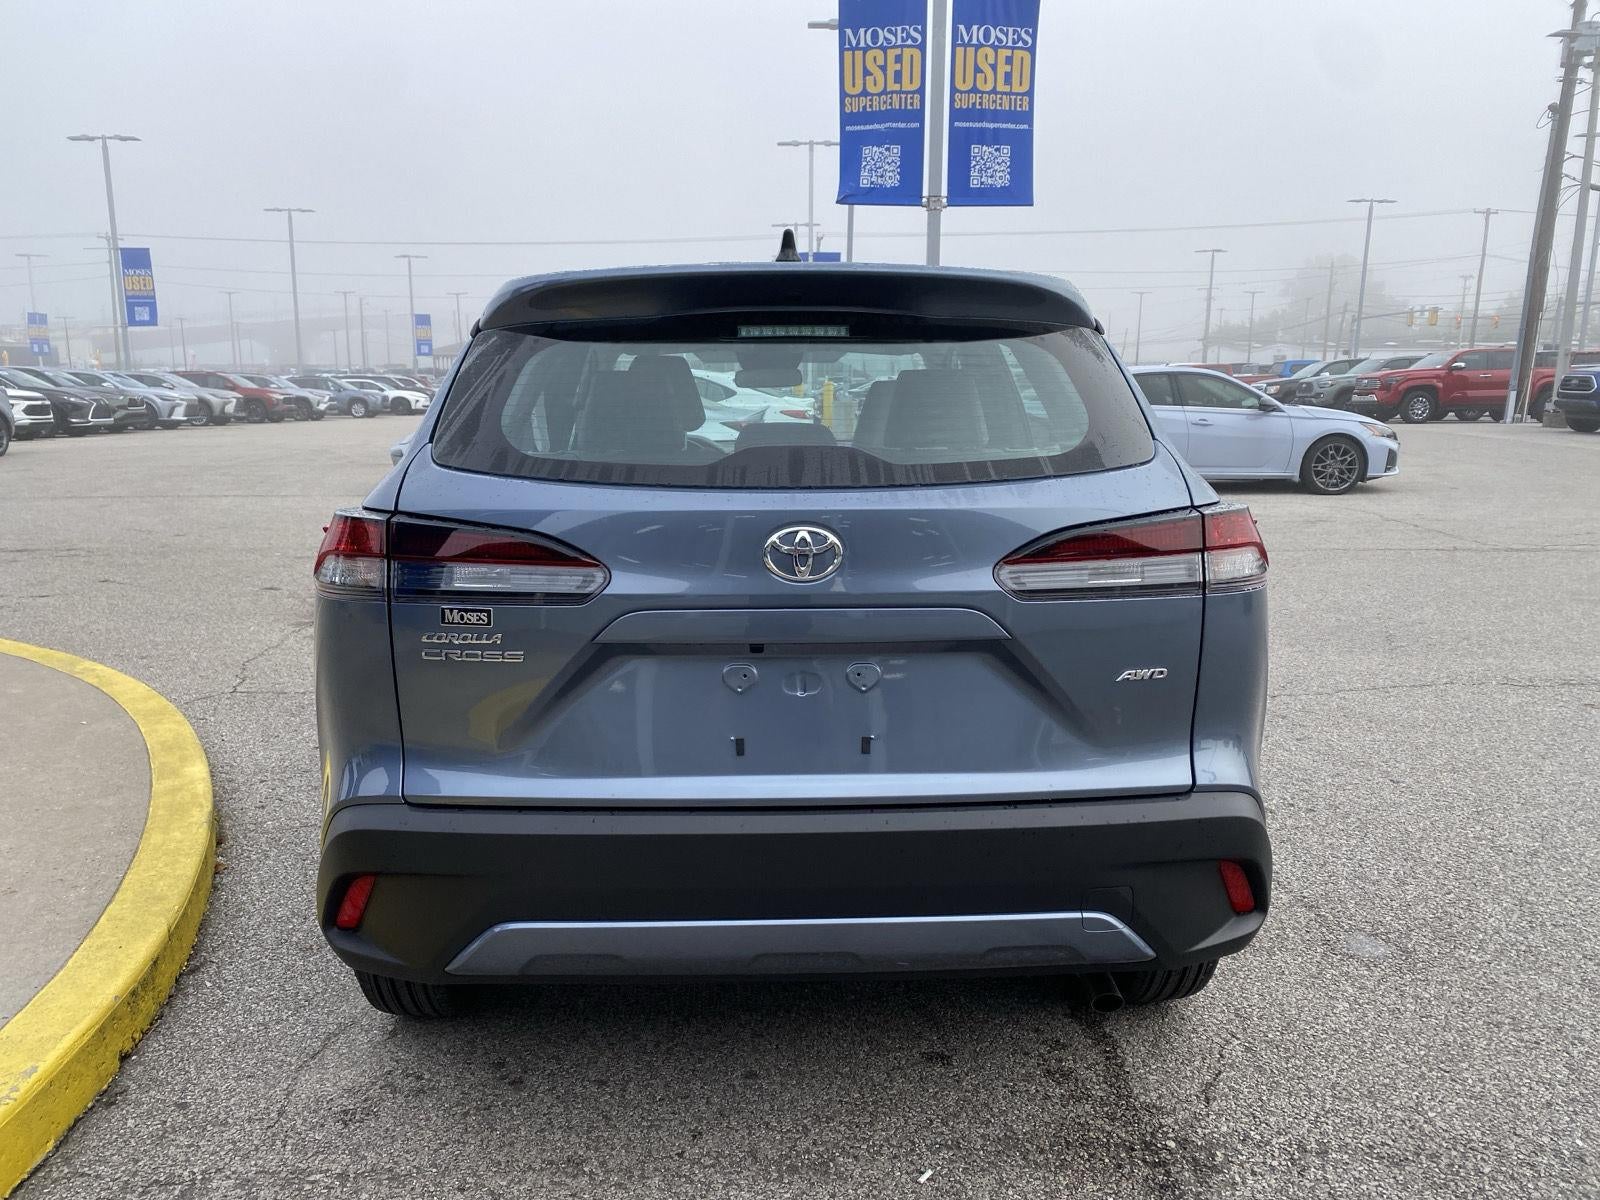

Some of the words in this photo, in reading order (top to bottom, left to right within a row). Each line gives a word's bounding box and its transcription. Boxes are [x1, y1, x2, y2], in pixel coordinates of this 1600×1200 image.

[844, 25, 922, 48] MOSES
[956, 24, 1032, 48] MOSES
[843, 48, 921, 95] USED
[954, 47, 1031, 93] USED
[844, 94, 920, 113] SUPERCENTER
[954, 93, 1029, 112] SUPERCENTER
[845, 122, 920, 131] mosesusedsupercenter.com
[954, 121, 1029, 130] mosesusedsupercenter.com
[125, 276, 153, 290] USED
[421, 632, 503, 644] COROLLA
[421, 649, 524, 662] CROSS
[1115, 668, 1168, 681] AWD
